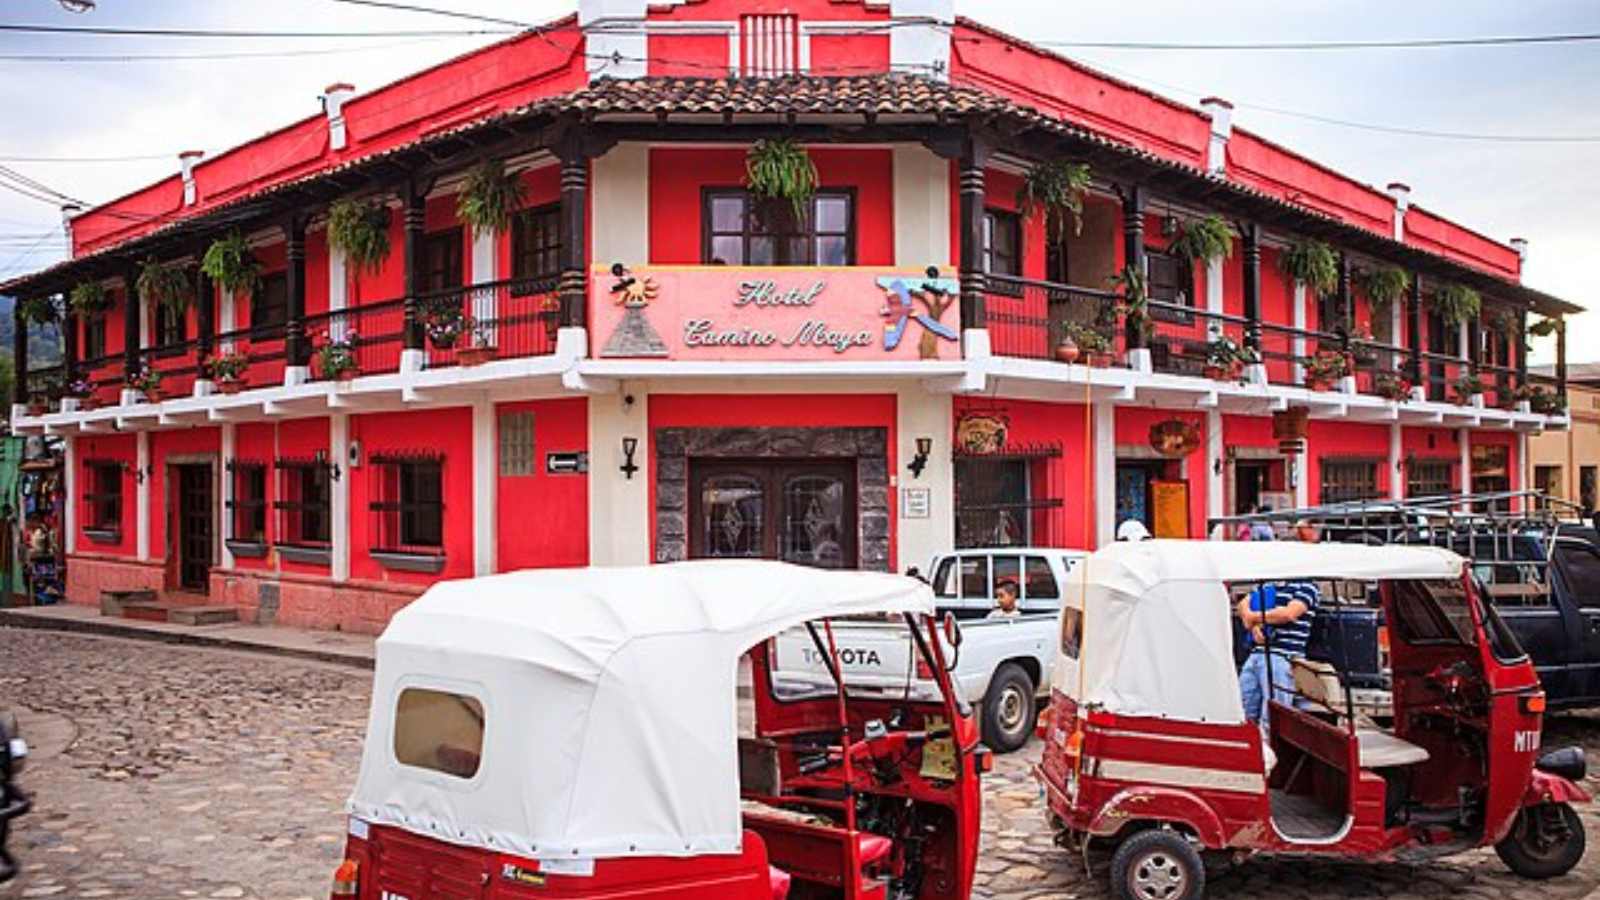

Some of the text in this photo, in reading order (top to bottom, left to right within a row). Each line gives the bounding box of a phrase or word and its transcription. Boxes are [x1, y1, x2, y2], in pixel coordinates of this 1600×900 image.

[733, 279, 825, 307] Hotel
[684, 319, 873, 353] Camino Maya
[802, 648, 881, 665] TOOTA
